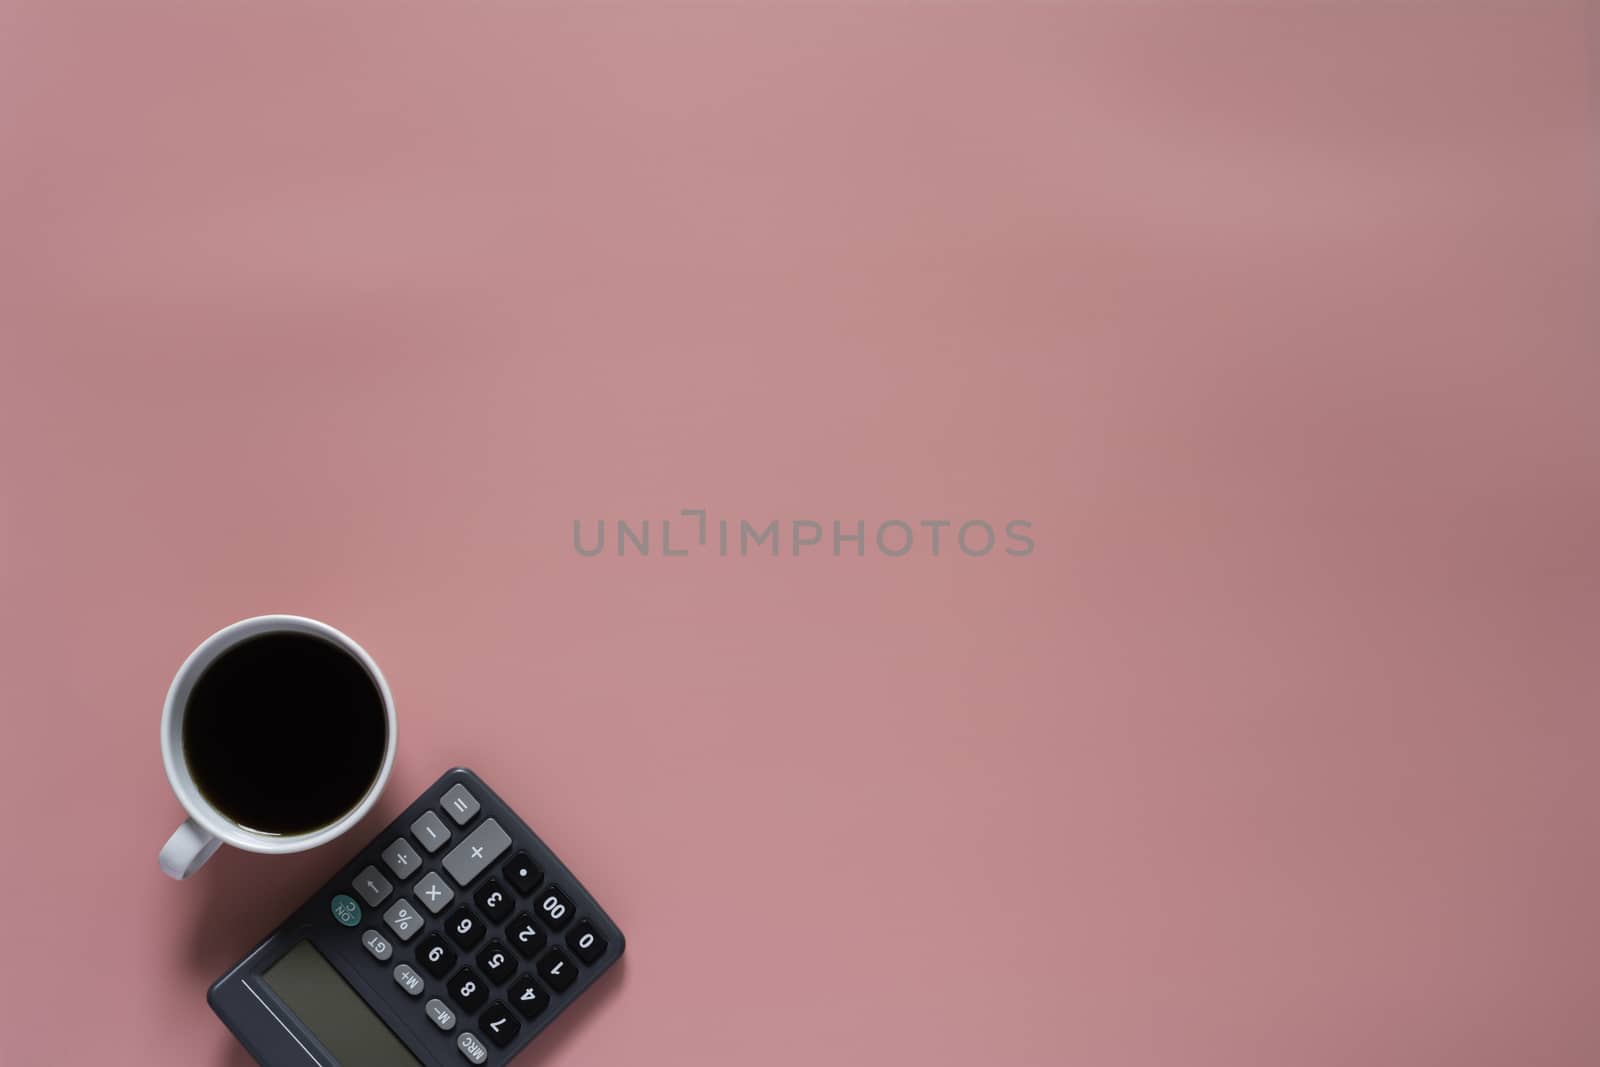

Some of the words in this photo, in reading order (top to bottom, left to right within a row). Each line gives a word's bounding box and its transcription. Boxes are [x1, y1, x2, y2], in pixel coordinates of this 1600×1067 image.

[487, 892, 502, 907] 3
[543, 896, 566, 919] 00
[457, 918, 472, 934] 6
[518, 925, 536, 942] 2
[367, 936, 386, 954] GT
[579, 933, 594, 949] 0
[428, 946, 444, 962] 9
[488, 953, 505, 969] 5
[550, 961, 564, 975] 1
[401, 971, 420, 990] M+
[460, 981, 476, 997] 8
[520, 987, 536, 1001] 4
[489, 1018, 507, 1033] 7
[462, 1037, 485, 1061] MRC
